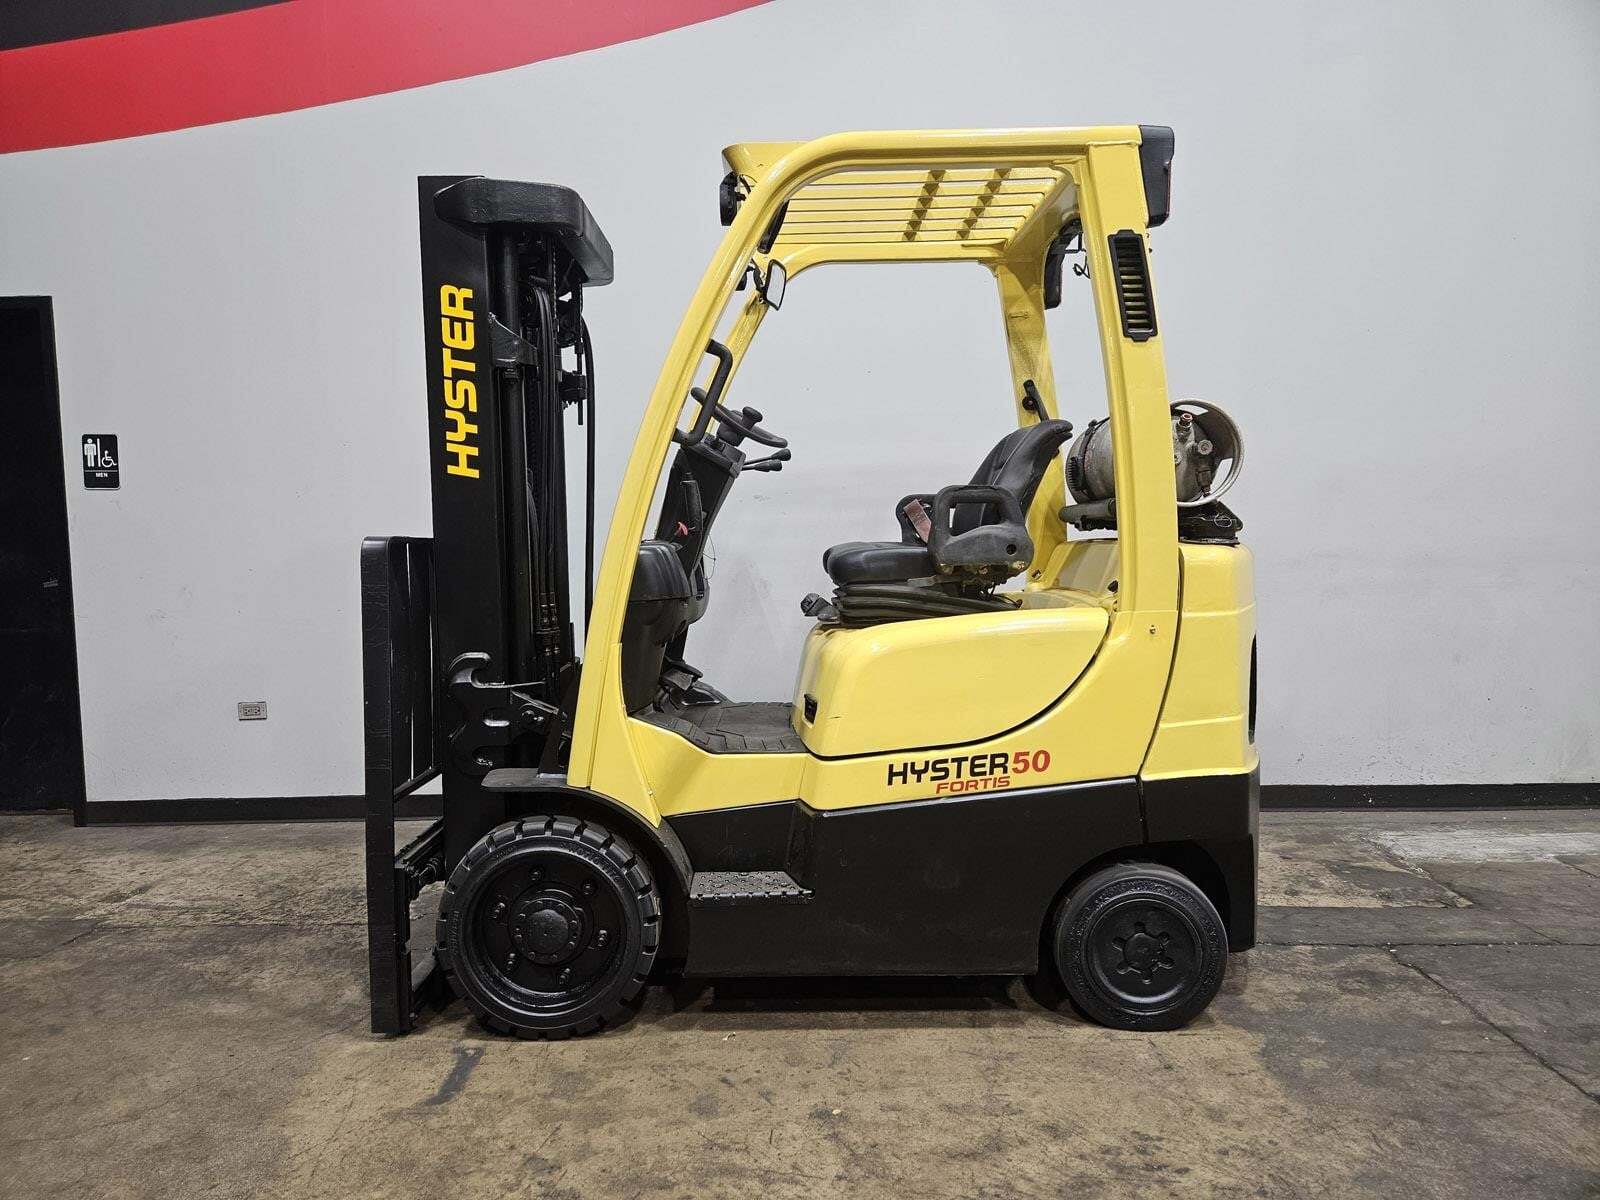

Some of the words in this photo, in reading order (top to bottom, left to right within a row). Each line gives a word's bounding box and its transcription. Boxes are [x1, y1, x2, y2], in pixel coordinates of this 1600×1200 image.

[440, 284, 480, 479] HYSTER
[887, 752, 1009, 786] HYSTER
[1011, 749, 1051, 774] 50
[935, 776, 1011, 794] FORTIS
